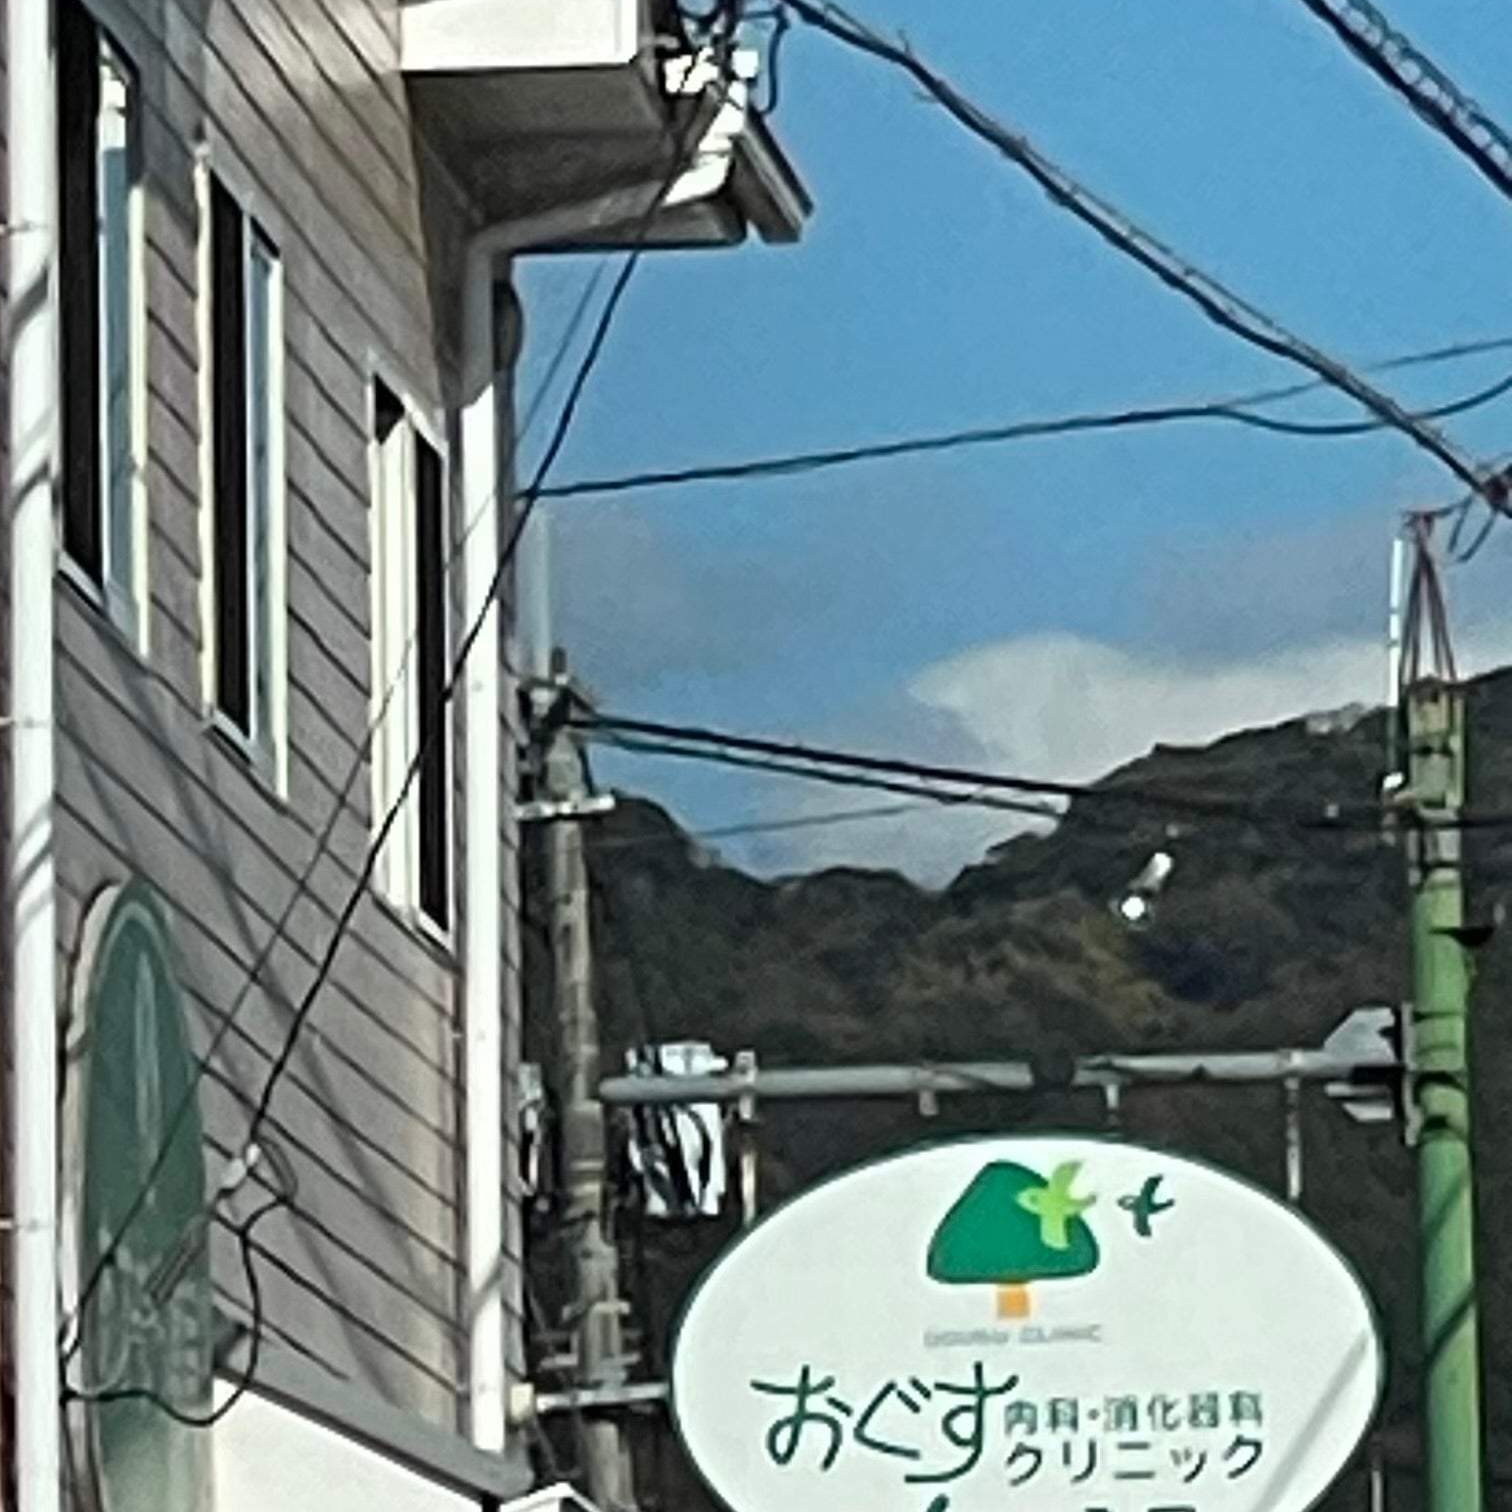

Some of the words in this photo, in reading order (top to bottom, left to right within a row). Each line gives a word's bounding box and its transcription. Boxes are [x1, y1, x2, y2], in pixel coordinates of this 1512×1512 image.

[750, 1361, 1019, 1483] おぐす
[1005, 1435, 1264, 1486] クリニック
